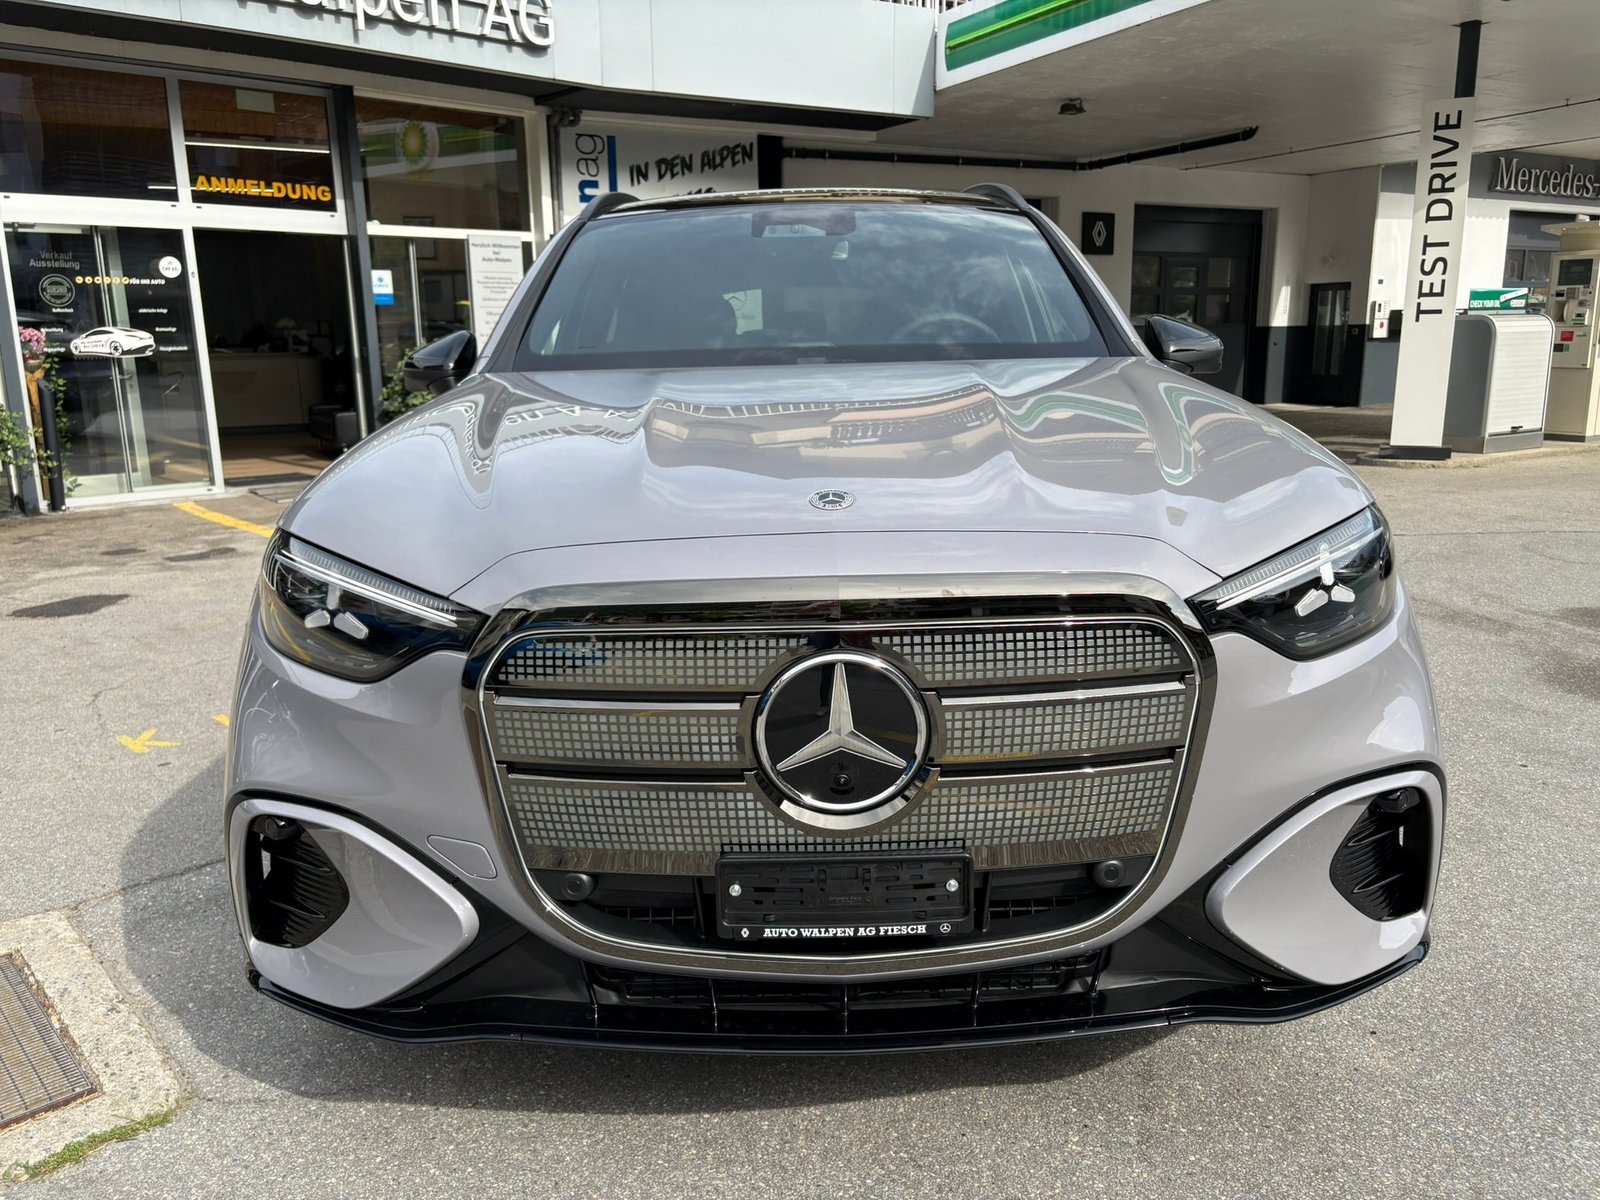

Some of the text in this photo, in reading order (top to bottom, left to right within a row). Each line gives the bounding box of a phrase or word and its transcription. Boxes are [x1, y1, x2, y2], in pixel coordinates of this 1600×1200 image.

[302, 0, 554, 46] pen AG
[628, 141, 755, 187] IN DEN ALPEN
[195, 175, 332, 202] ANMELDUNG
[1415, 110, 1462, 323] TEST DRIVE
[40, 251, 73, 260] Verkauf
[29, 258, 81, 271] Ausstellung
[151, 278, 166, 286] AUTO
[1470, 299, 1483, 308] CHECK
[763, 924, 927, 938] AUTO WALPEN AG FIESCH
